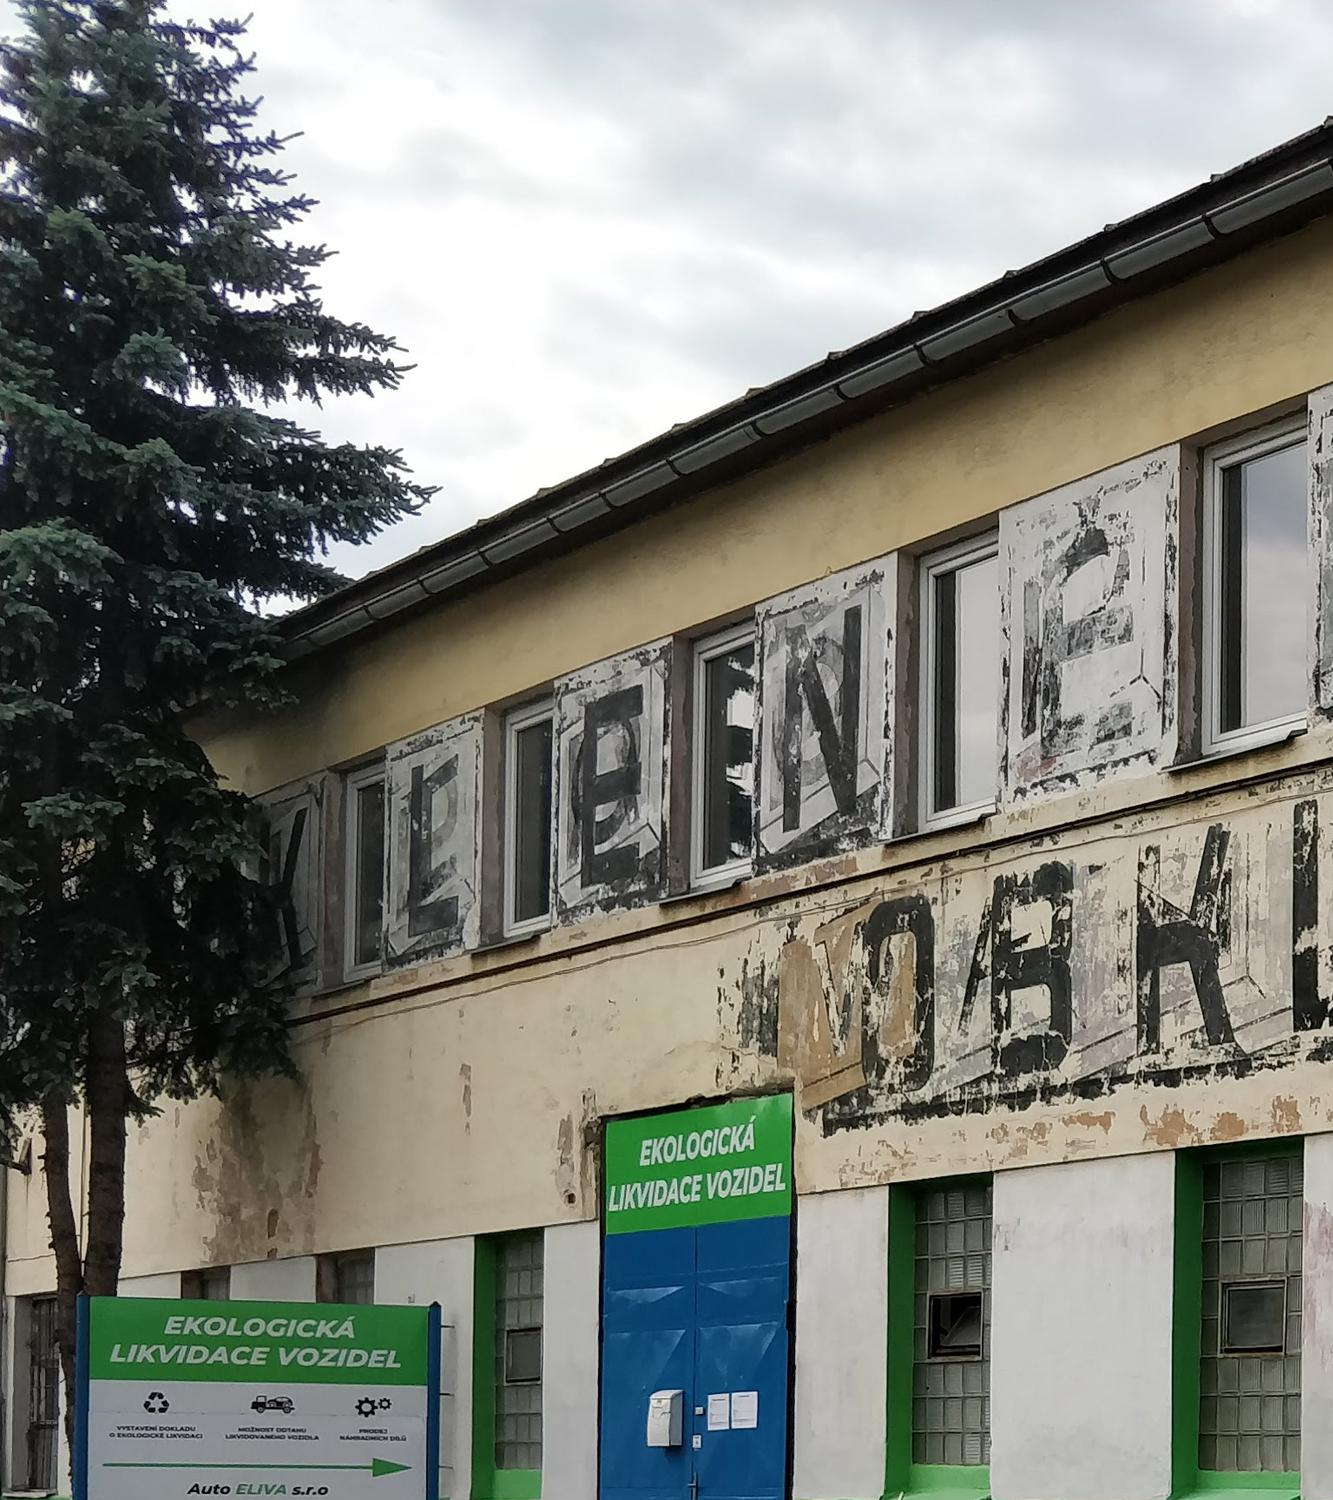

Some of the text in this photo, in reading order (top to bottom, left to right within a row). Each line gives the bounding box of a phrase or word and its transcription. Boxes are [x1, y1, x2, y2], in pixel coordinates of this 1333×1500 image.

[639, 1115, 757, 1167] EKOLOGICKÁ
[608, 1162, 786, 1212] LIKVIDACE VOZIDEL
[164, 1316, 356, 1339] EKOLOGICKÁ
[109, 1344, 402, 1369] LIKVIDACE VOZIDEL
[187, 1483, 329, 1495] Auto ELIVA s.r.o
